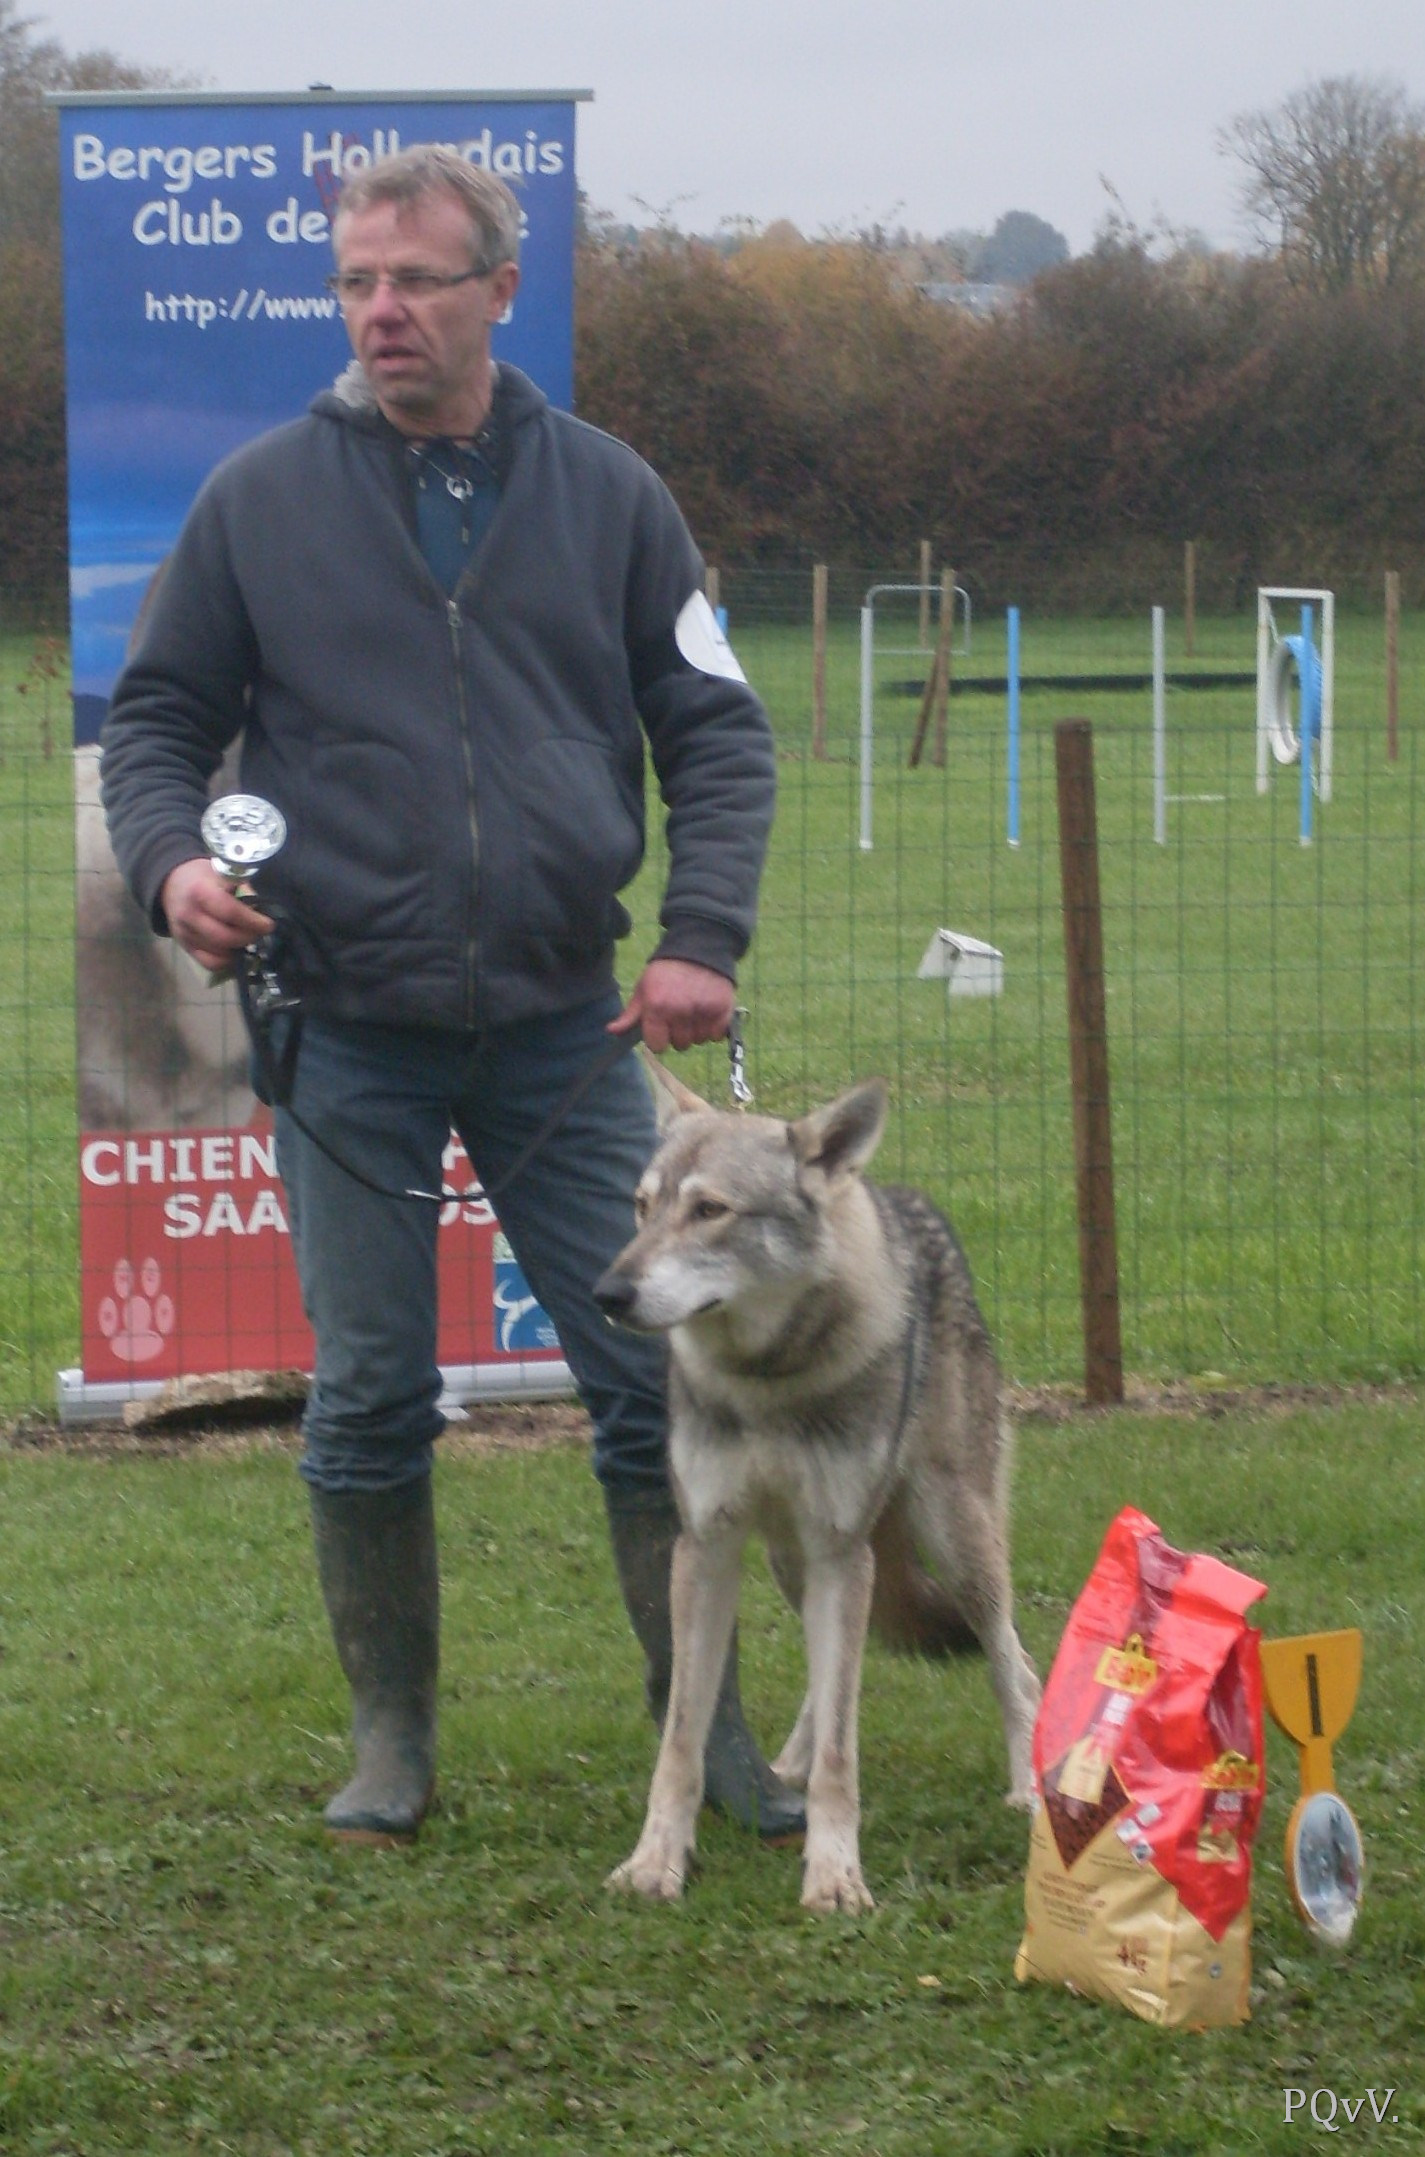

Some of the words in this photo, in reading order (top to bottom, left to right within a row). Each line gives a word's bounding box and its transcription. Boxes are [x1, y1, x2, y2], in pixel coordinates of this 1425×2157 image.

[73, 133, 277, 194] Bergers
[303, 128, 564, 177] Holldais
[132, 197, 242, 246] Club
[265, 197, 328, 243] de
